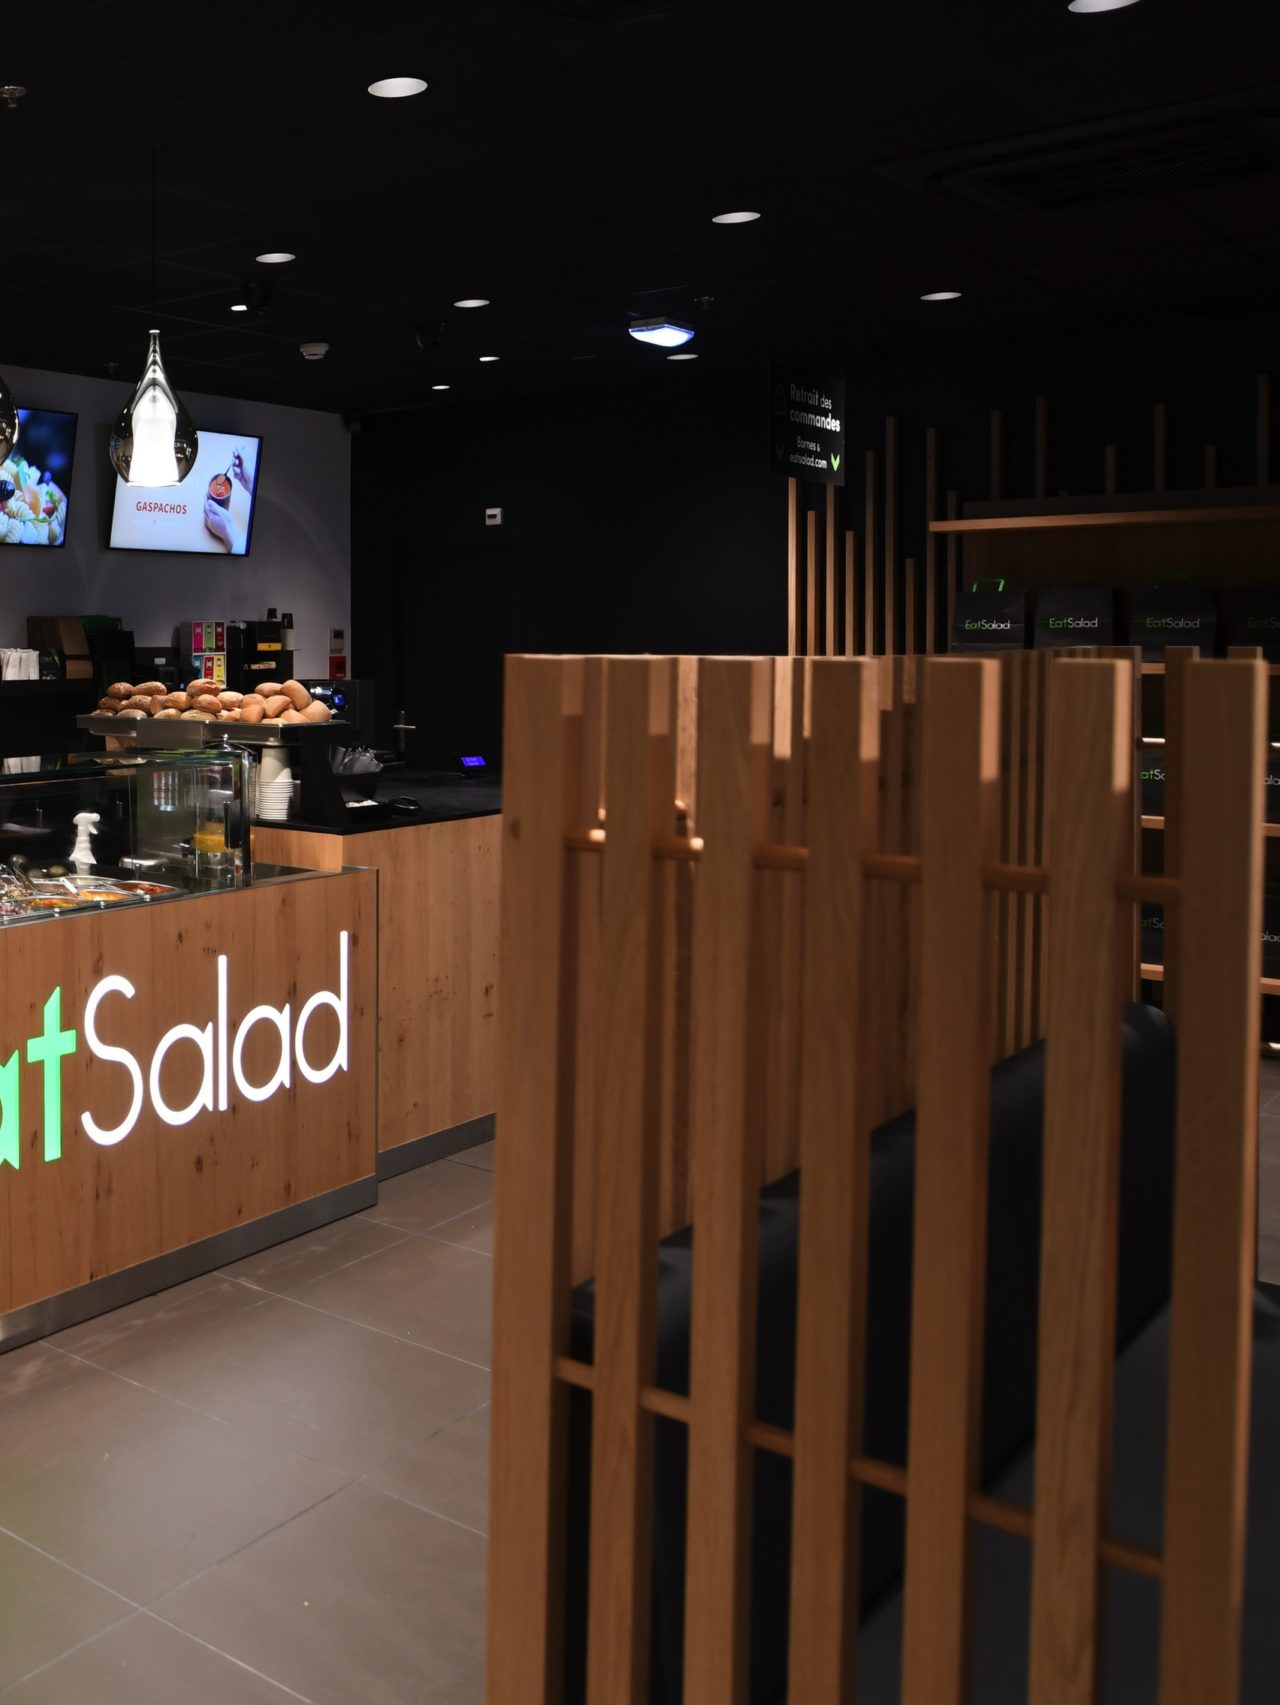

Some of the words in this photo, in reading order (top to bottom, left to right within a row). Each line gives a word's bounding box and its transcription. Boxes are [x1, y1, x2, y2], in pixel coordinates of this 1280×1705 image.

[790, 383, 819, 406] Retrait
[820, 394, 832, 410] des
[790, 409, 841, 432] commandes
[797, 436, 816, 451] Bornes
[790, 453, 828, 469] eatsalad.com
[136, 501, 187, 515] GASPACHOS
[965, 619, 1011, 631] EatSalad
[1049, 617, 1098, 629] EatSalad
[1147, 617, 1200, 629] EatSalad
